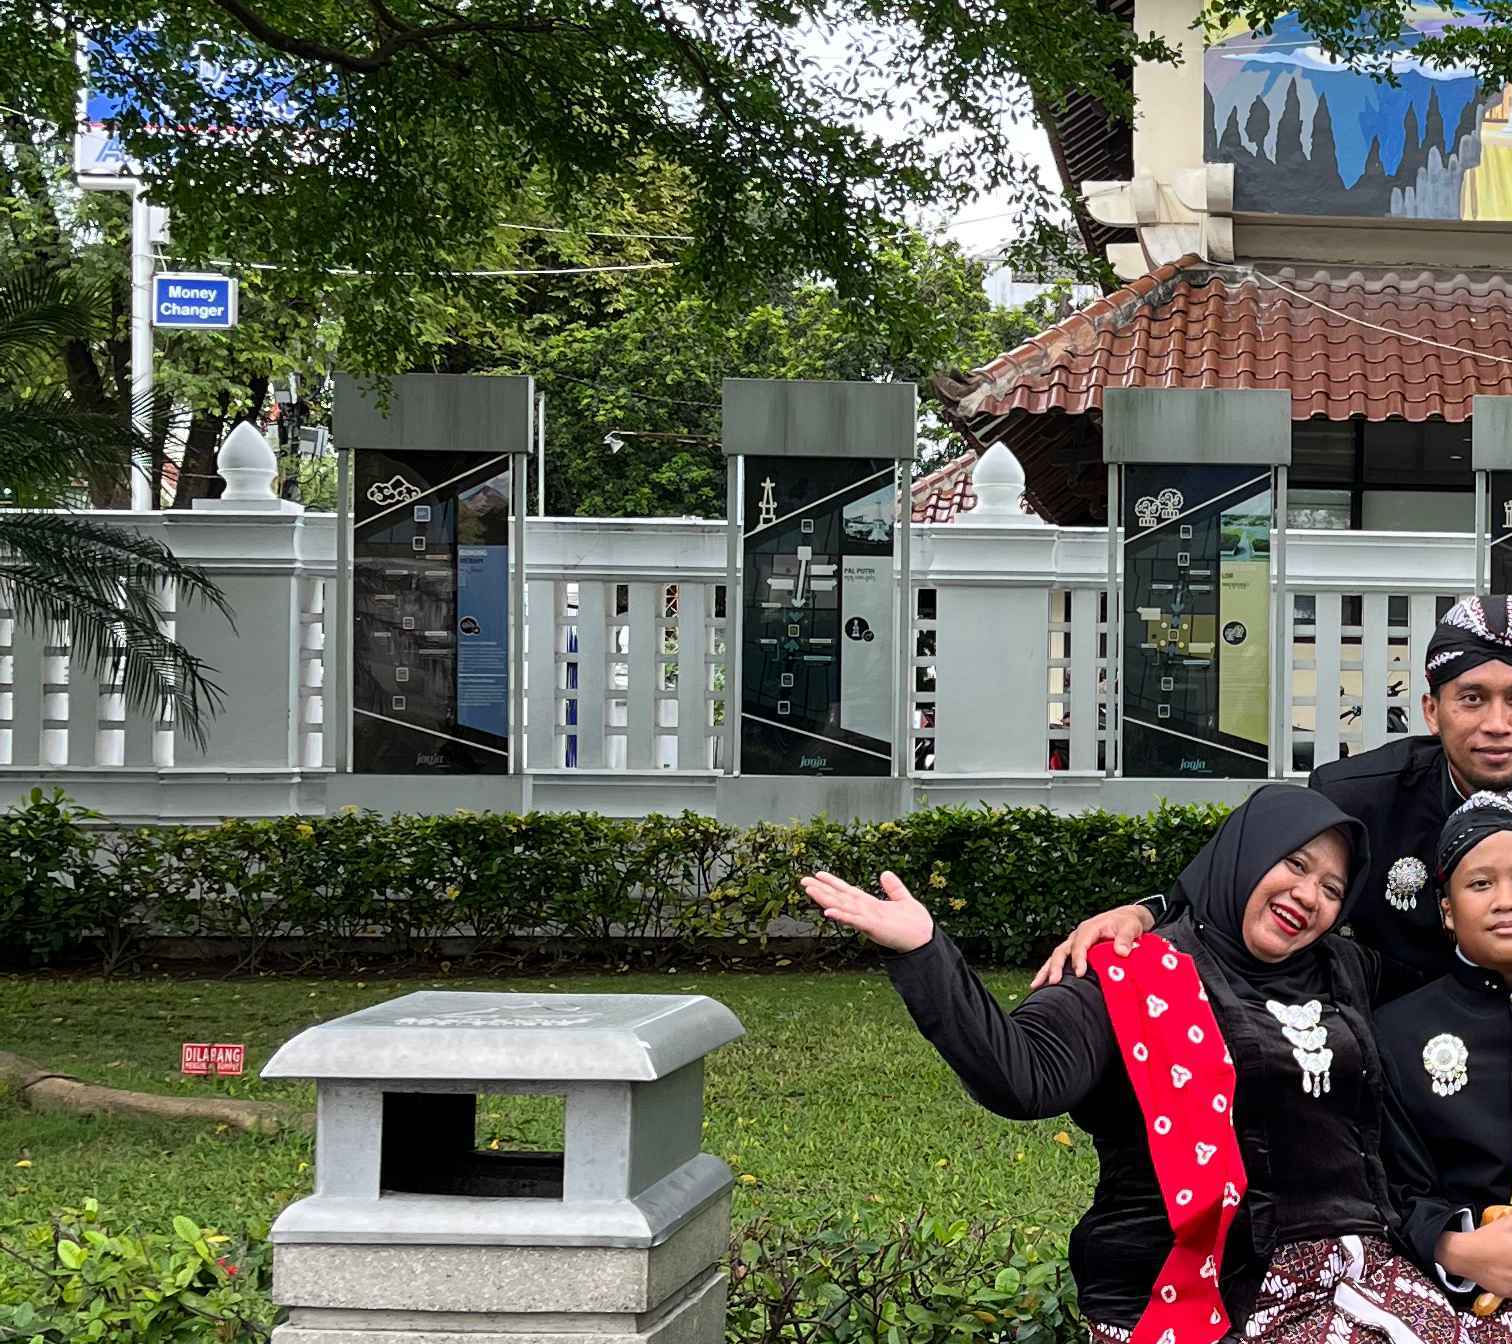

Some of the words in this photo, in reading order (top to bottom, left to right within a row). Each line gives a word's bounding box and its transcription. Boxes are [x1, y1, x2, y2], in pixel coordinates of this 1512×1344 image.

[168, 285, 217, 302] Money
[159, 302, 224, 320] Changer
[185, 1047, 241, 1062] DILARANG
